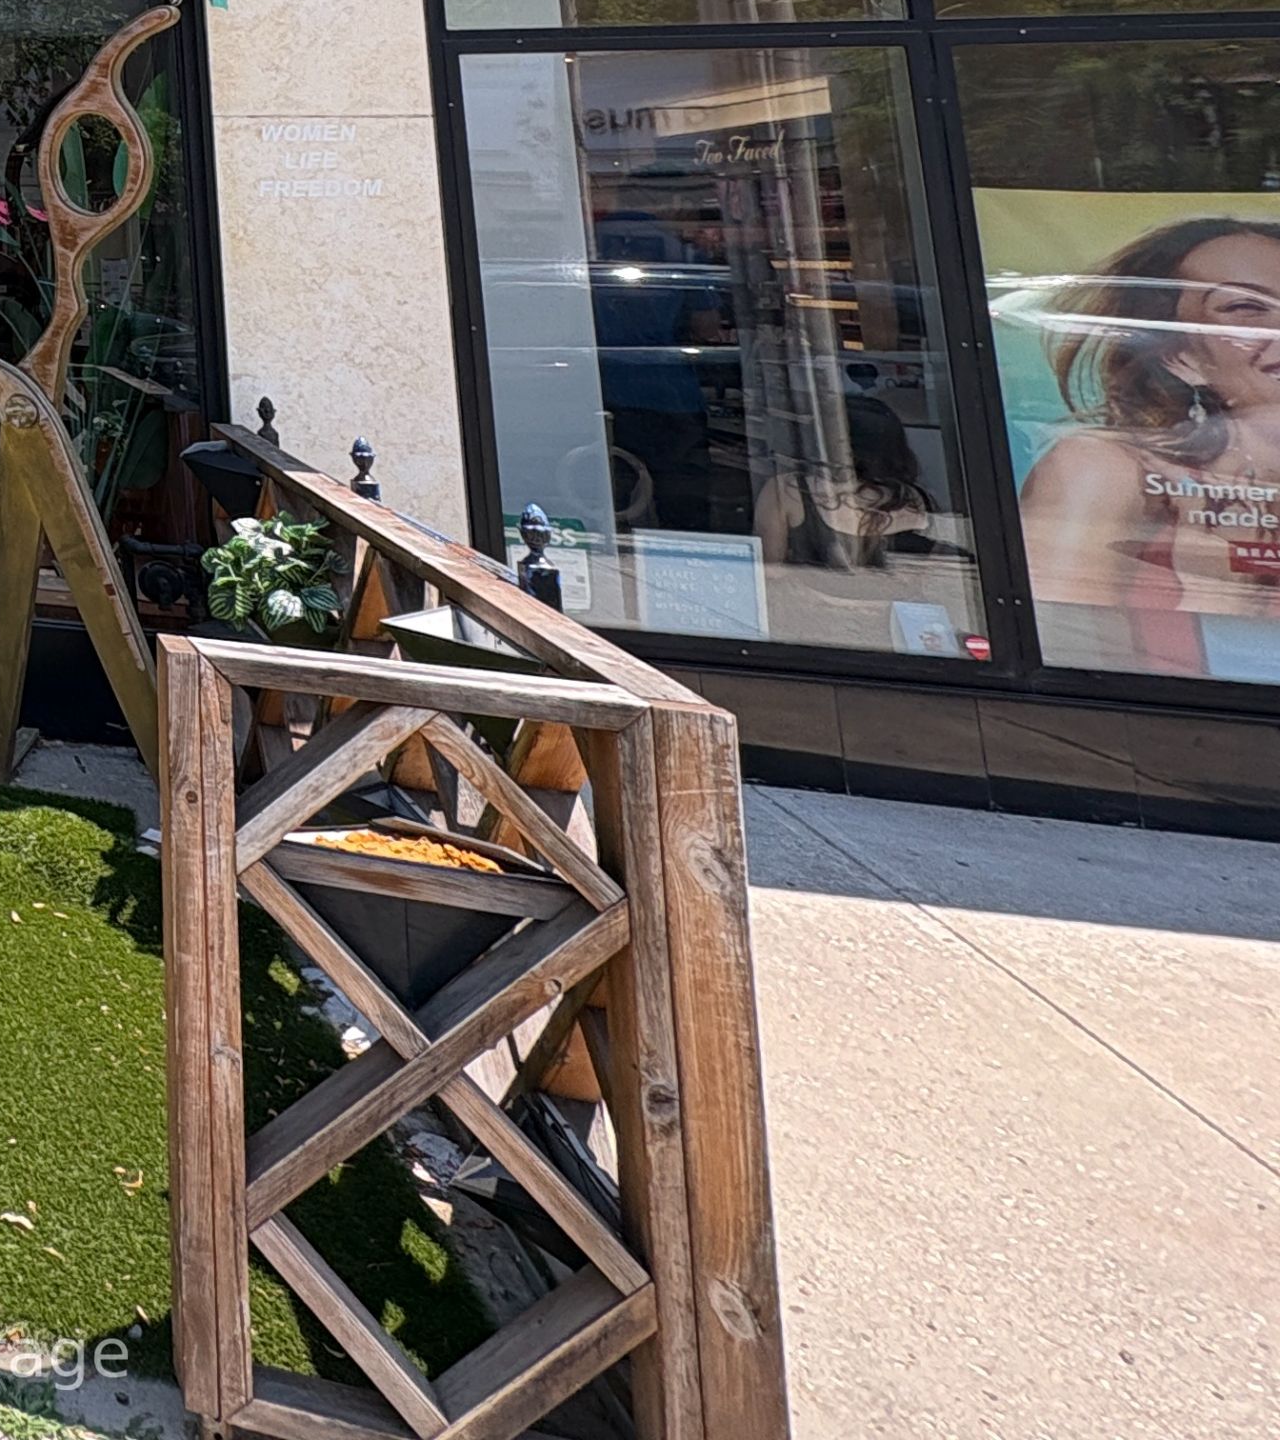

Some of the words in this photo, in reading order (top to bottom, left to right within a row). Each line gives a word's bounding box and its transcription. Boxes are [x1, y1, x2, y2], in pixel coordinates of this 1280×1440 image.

[260, 123, 357, 143] WOMEN
[283, 151, 338, 169] LIFE
[258, 178, 384, 198] FREEDOM
[1145, 473, 1279, 502] Summer
[1188, 507, 1279, 529] made
[1236, 547, 1280, 559] BEA
